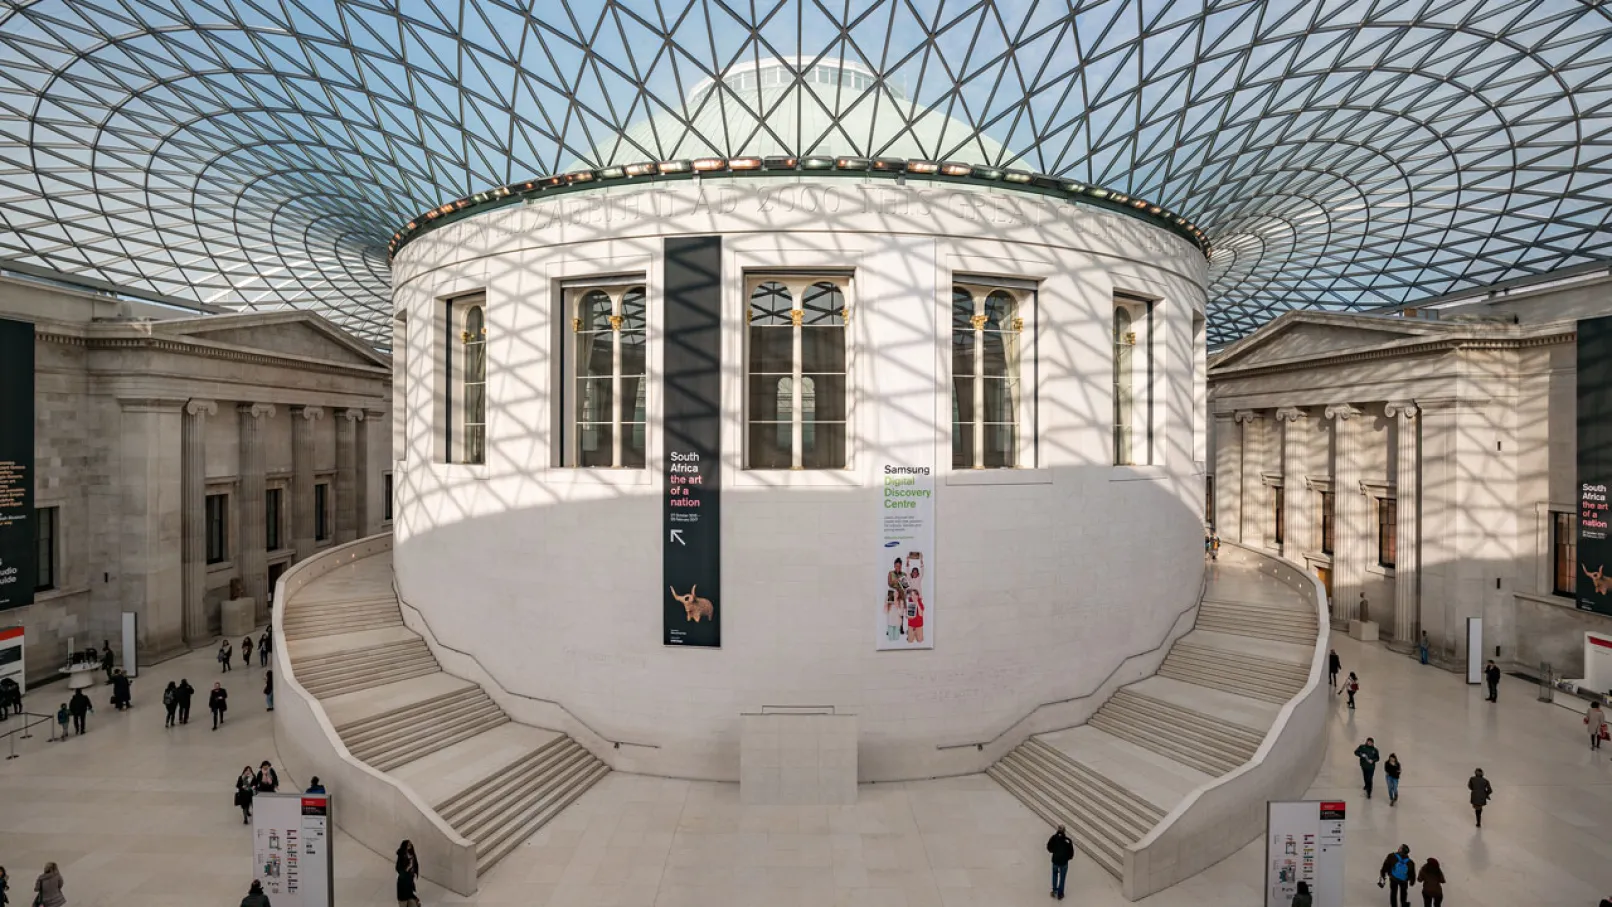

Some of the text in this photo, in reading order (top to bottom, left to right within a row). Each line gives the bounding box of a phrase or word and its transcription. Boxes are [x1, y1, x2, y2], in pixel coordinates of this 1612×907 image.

[691, 187, 738, 215] AD
[757, 187, 840, 213] 2000
[670, 451, 700, 461] South
[670, 463, 698, 473] Africa
[884, 464, 930, 475] Samsung
[670, 475, 702, 484] the art
[884, 476, 915, 487] Digital
[670, 486, 680, 495] of
[1582, 484, 1607, 492] South
[884, 488, 931, 498] Discovery
[1582, 492, 1606, 501] Africa
[670, 497, 700, 507] nation
[884, 499, 916, 508] Centre
[1582, 501, 1594, 509] the
[1582, 519, 1608, 528] nation
